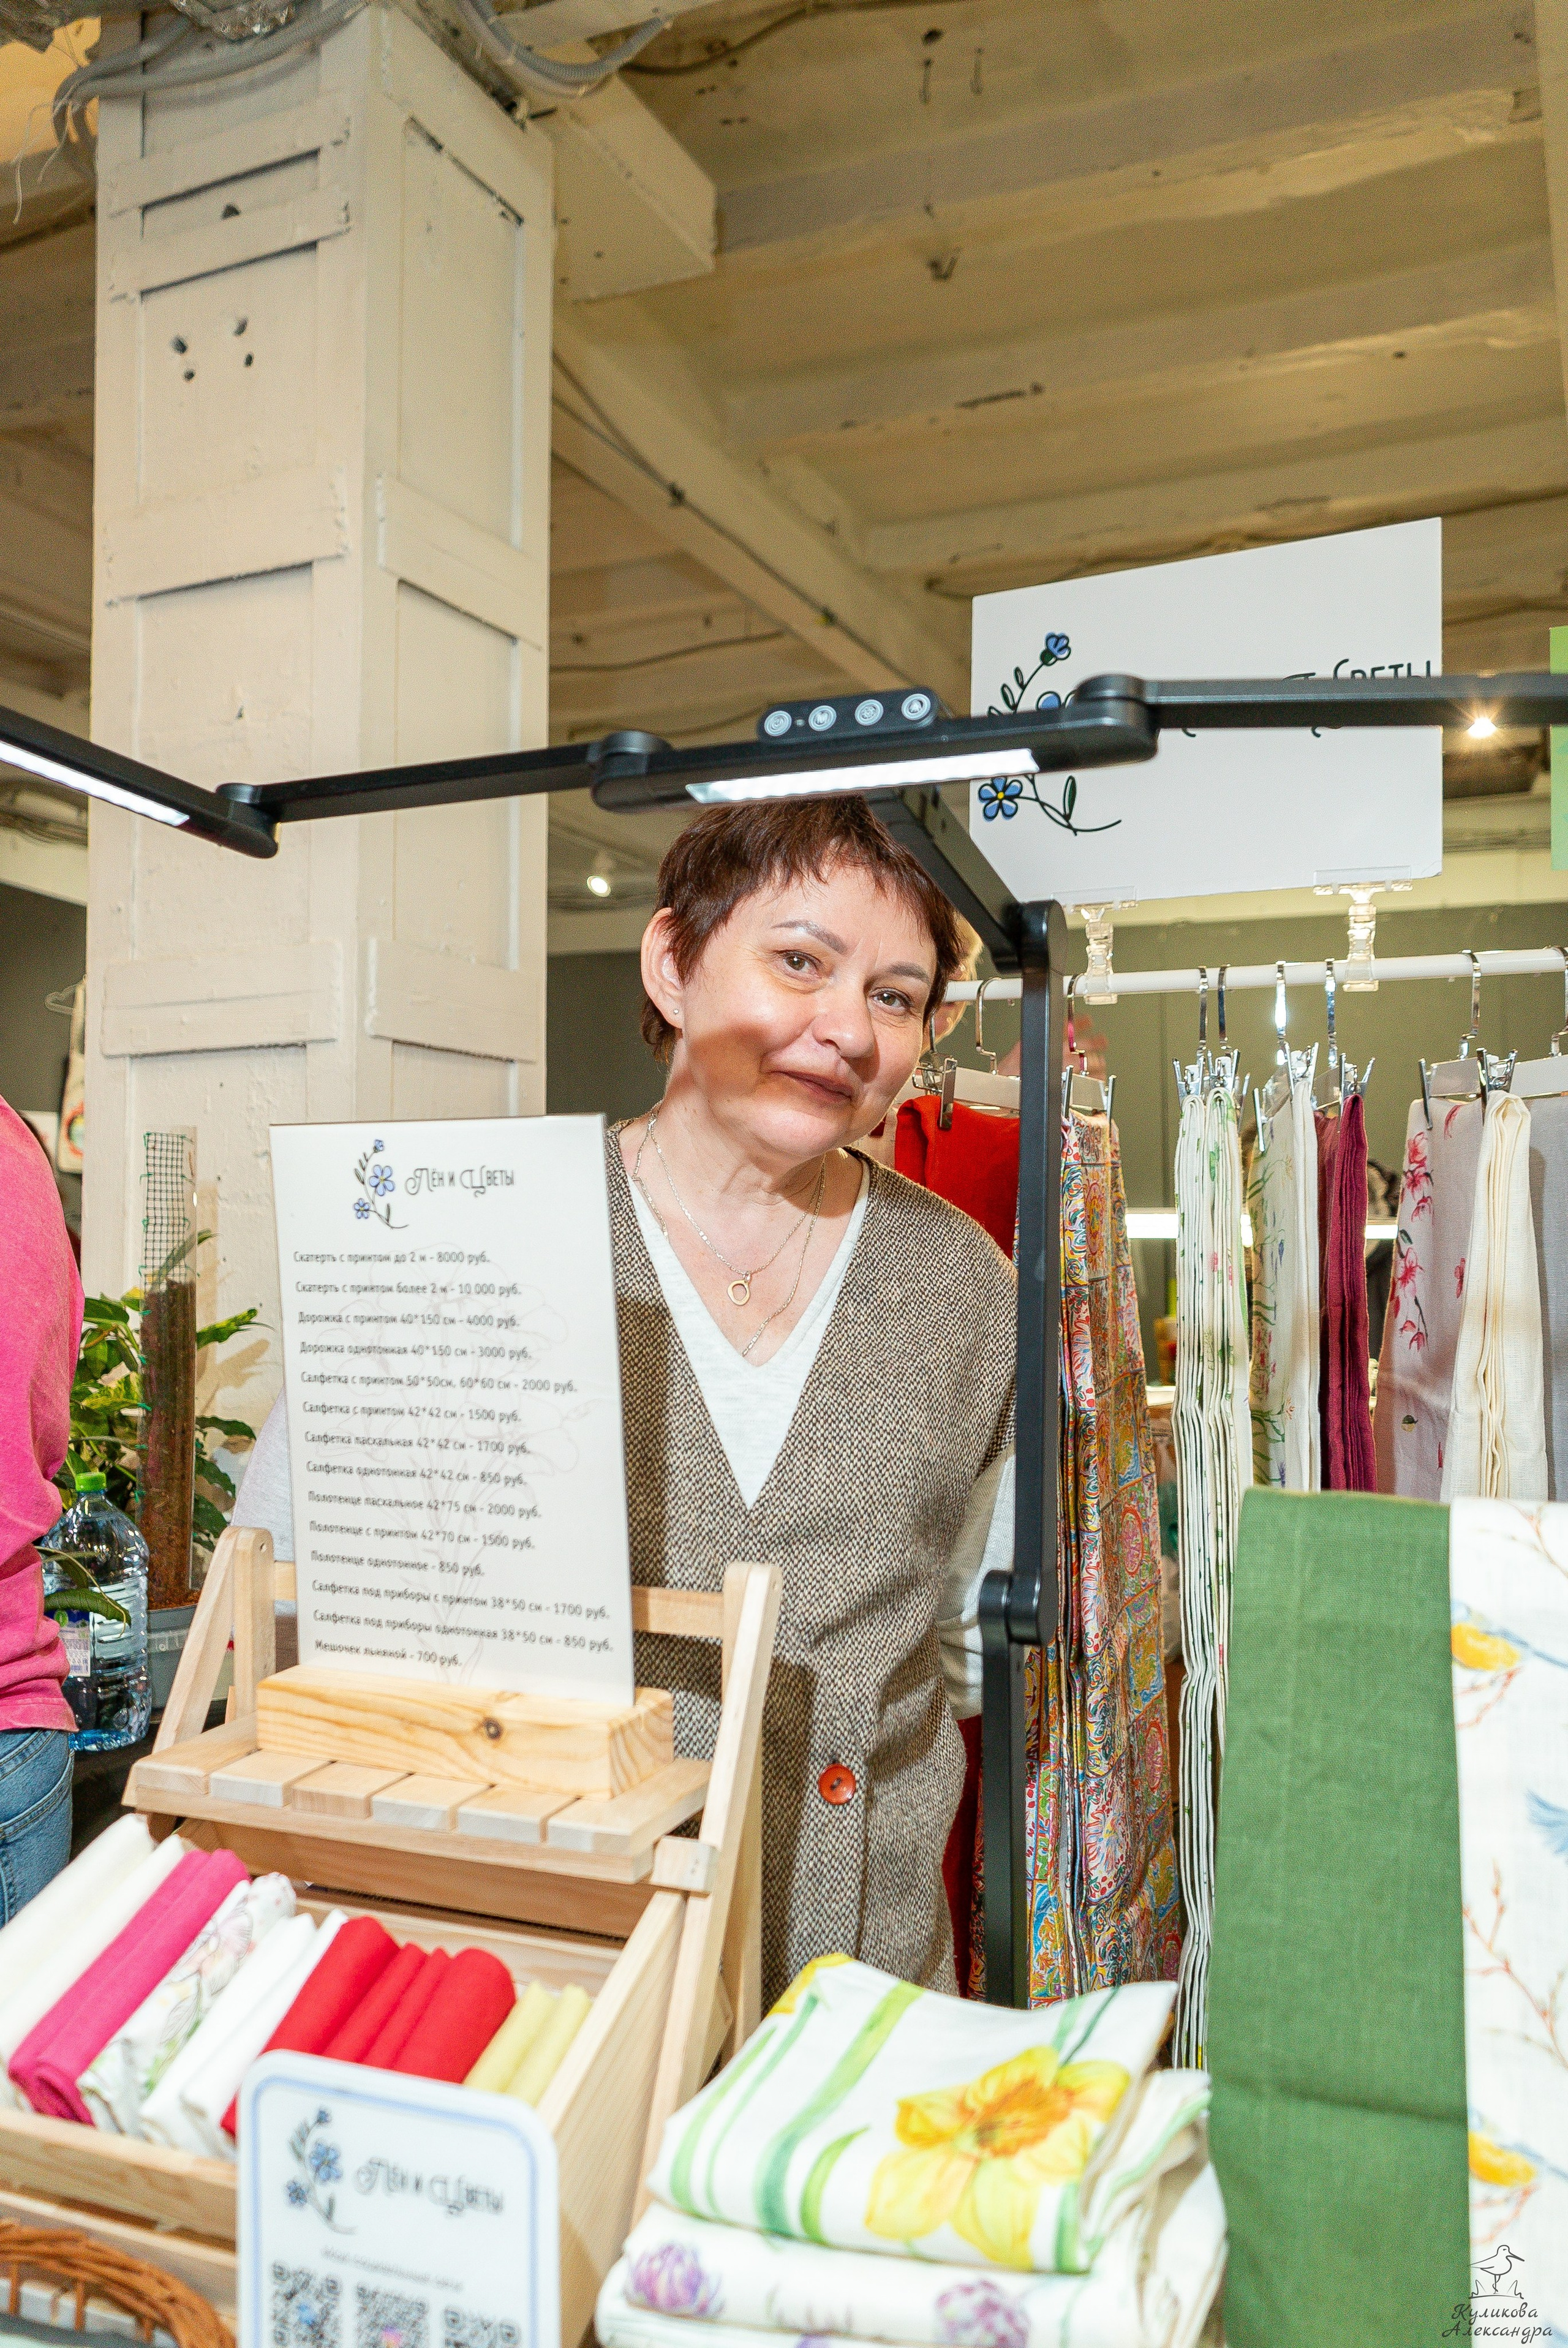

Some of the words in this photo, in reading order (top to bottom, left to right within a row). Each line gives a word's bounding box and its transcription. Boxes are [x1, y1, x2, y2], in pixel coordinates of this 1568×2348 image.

[293, 1251, 337, 1264] Скатерть
[347, 1255, 391, 1264] принтом
[394, 1254, 407, 1264] до
[410, 1251, 416, 1263] 2
[437, 1251, 465, 1263] 8000
[467, 1251, 490, 1266] руб.
[296, 1282, 339, 1294] Скатерть
[350, 1285, 394, 1295] принтом
[396, 1282, 427, 1294] более
[431, 1283, 437, 1294] 2
[440, 1286, 448, 1294] м
[499, 1283, 521, 1297] руб.
[298, 1312, 343, 1324] Дорожка
[353, 1315, 398, 1326] принтом
[466, 1315, 494, 1326] 4000
[497, 1315, 519, 1329] руб.
[300, 1342, 345, 1354] Дорожка
[347, 1345, 408, 1355] однотонная
[478, 1346, 505, 1357] 3000
[508, 1346, 532, 1361] руб.
[301, 1372, 349, 1385] Салфетка
[360, 1376, 404, 1387] принтом
[497, 1380, 511, 1389] см
[522, 1379, 550, 1391] 2000
[554, 1380, 577, 1394] руб.
[303, 1402, 350, 1415] Салфетка
[353, 1406, 358, 1415] с
[360, 1406, 405, 1417] принтом
[443, 1410, 457, 1419] см
[469, 1409, 496, 1421] 1500
[499, 1410, 521, 1424] руб.
[304, 1431, 352, 1446] Салфетка
[355, 1436, 413, 1447] пасхальная
[453, 1441, 466, 1450] см
[478, 1440, 504, 1453] 1700
[508, 1442, 532, 1456] руб.
[306, 1461, 353, 1475] Салфетка
[356, 1467, 417, 1478] однотонная
[456, 1472, 469, 1482] см
[480, 1471, 501, 1484] 850
[503, 1473, 527, 1487] руб.
[308, 1490, 361, 1506] Полотенце
[364, 1497, 423, 1509] пасхальное
[463, 1503, 477, 1514] см
[488, 1503, 515, 1516] 2000
[518, 1505, 541, 1519] руб.
[309, 1520, 363, 1536] Полотенце
[366, 1528, 371, 1536] с
[374, 1528, 418, 1539] принтом
[457, 1534, 470, 1544] см
[482, 1533, 509, 1547] 1500
[512, 1536, 535, 1550] руб.
[311, 1550, 364, 1566] Полотенце
[367, 1558, 428, 1571] однотонное
[439, 1560, 459, 1574] 850
[462, 1563, 484, 1577] руб.
[312, 1580, 360, 1595] Салфетка
[362, 1587, 382, 1598] под
[383, 1588, 431, 1603] приборы
[434, 1594, 439, 1602] с
[442, 1595, 488, 1607] принтом
[529, 1603, 542, 1612] см
[554, 1603, 582, 1617] 1700
[586, 1606, 609, 1620] руб.
[314, 1609, 361, 1625] Салфетка
[364, 1617, 383, 1629] под
[385, 1618, 432, 1634] приборы
[435, 1625, 498, 1639] однотонная
[539, 1635, 552, 1645] см
[564, 1635, 586, 1648] 850
[589, 1638, 613, 1652] руб.
[315, 1640, 361, 1654] Мешочек
[364, 1647, 407, 1659] льняной
[418, 1651, 437, 1663] 700
[439, 1654, 462, 1667] руб.
